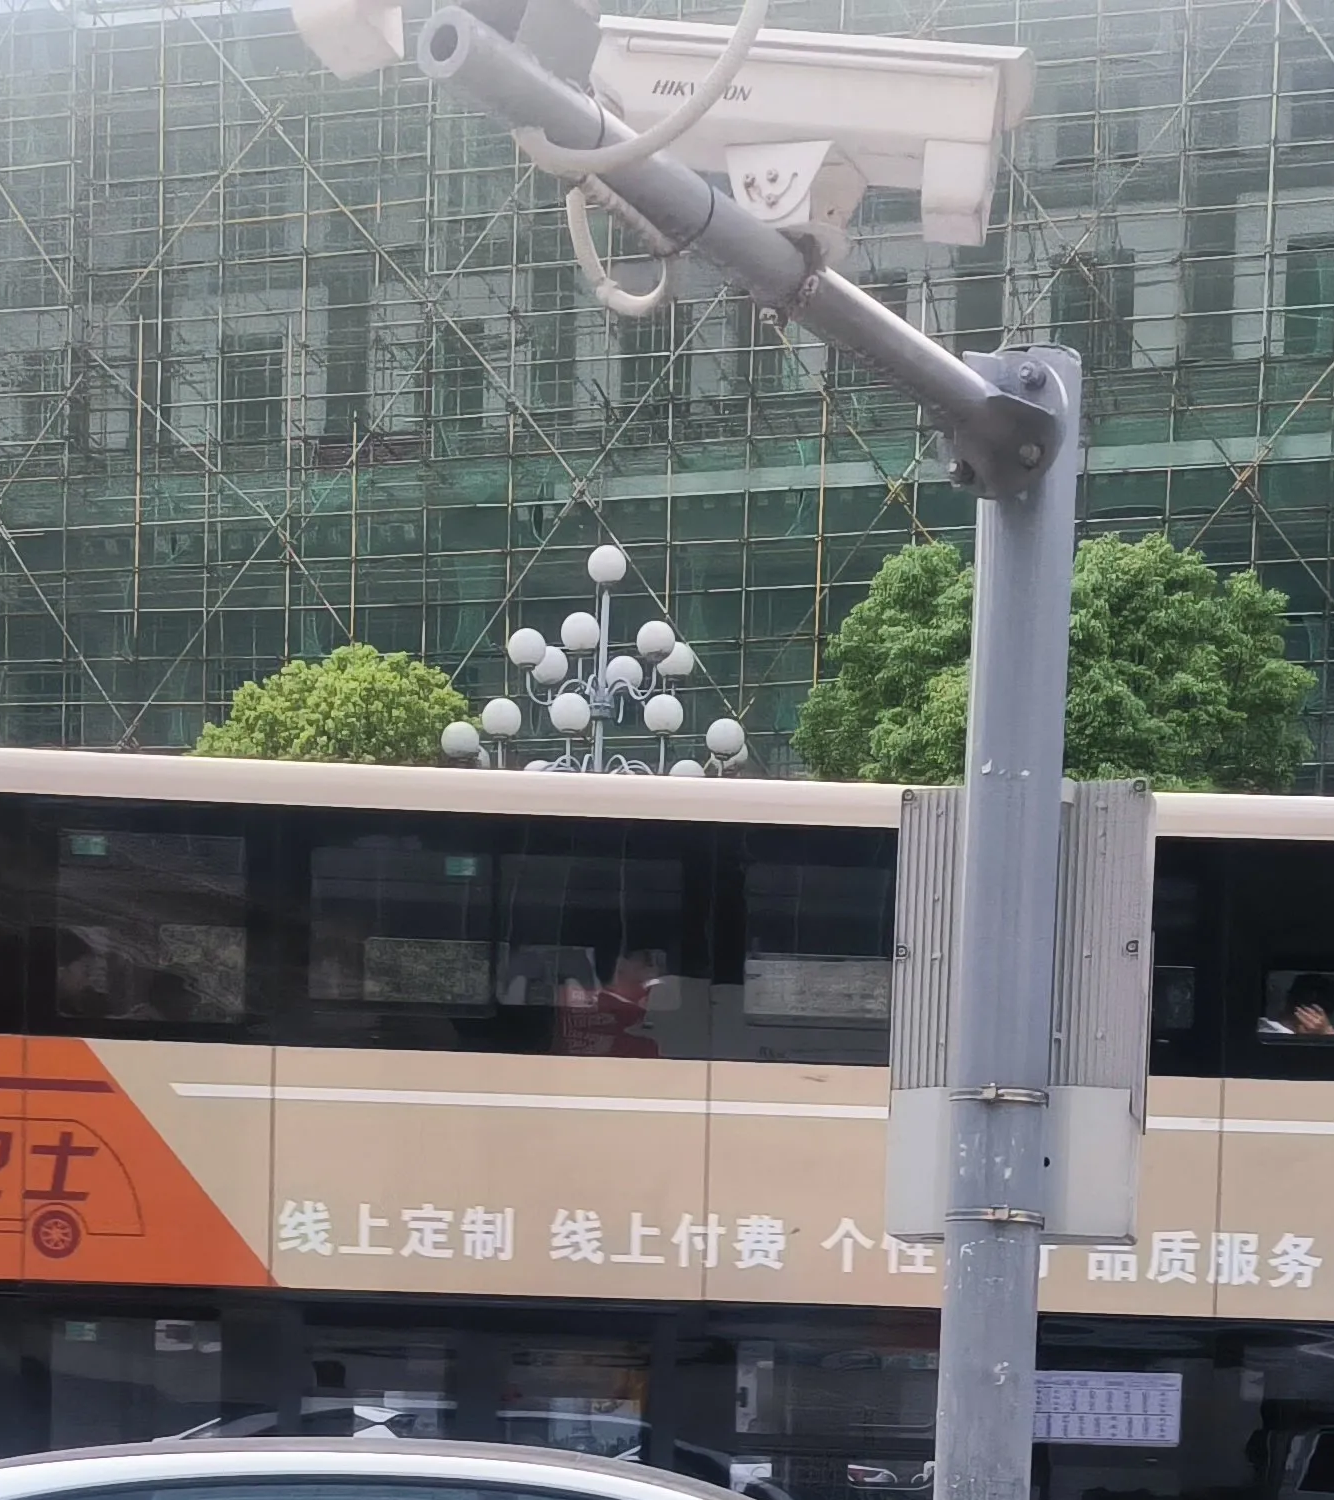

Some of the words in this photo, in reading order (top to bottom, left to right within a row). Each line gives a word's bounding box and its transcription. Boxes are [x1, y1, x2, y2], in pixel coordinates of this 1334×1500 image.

[277, 1200, 517, 1261] 线上定制
[549, 1207, 788, 1271] 线上付费
[1087, 1230, 1323, 1288] 品质服务
